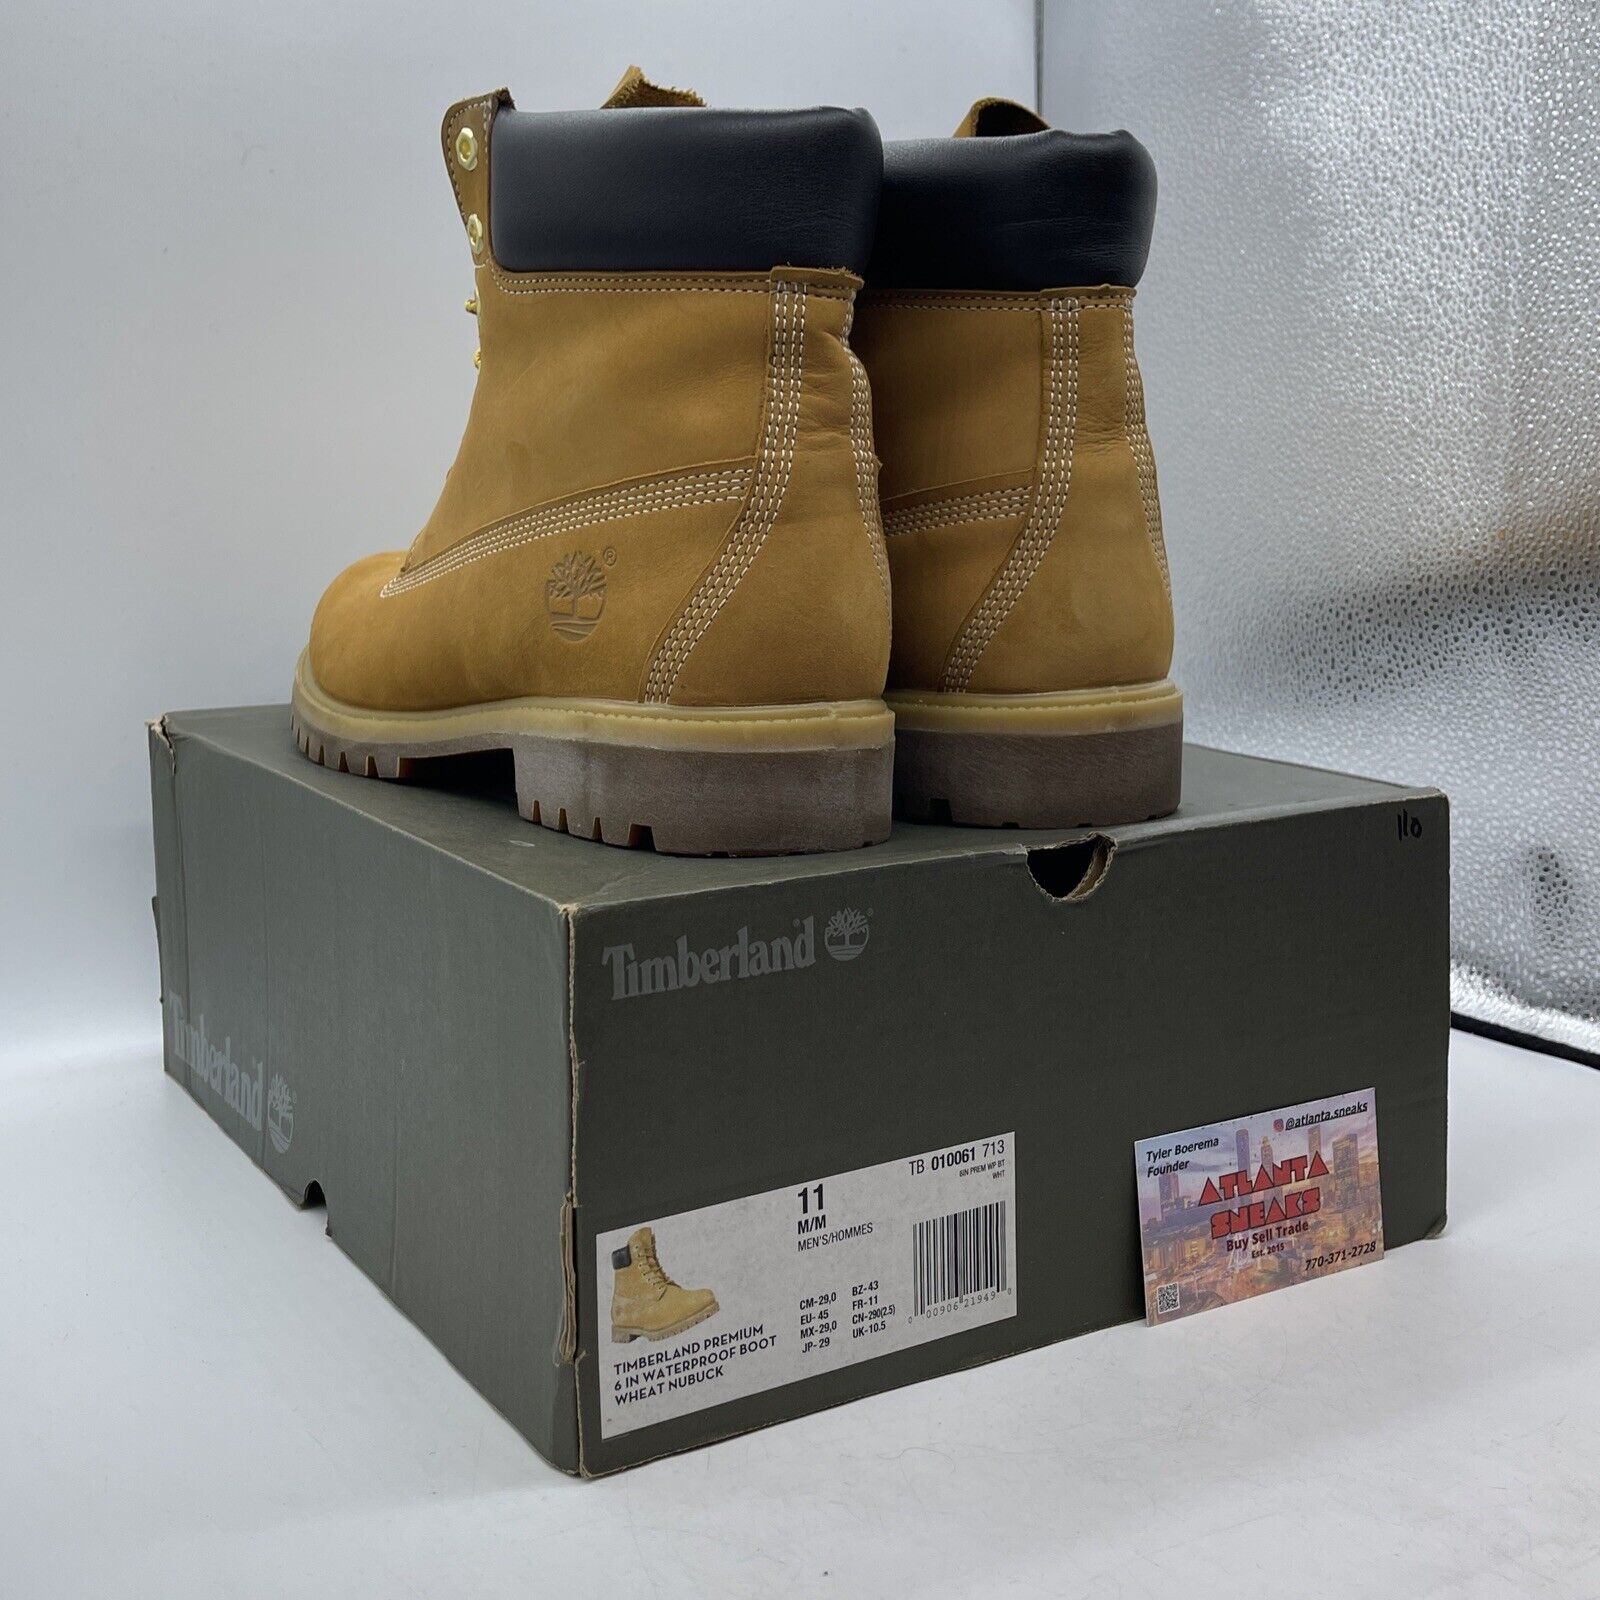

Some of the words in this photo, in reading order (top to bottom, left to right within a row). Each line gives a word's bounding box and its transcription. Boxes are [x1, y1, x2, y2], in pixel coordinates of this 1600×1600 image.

[601, 916, 817, 1000] Timberland
[169, 990, 264, 1131] Timberland
[1285, 1101, 1368, 1130] @atlanta.sneaks
[909, 1159, 925, 1176] TB
[931, 1147, 976, 1171] 010061
[982, 1139, 1005, 1157] 713
[1146, 1147, 1172, 1163] Tyler
[1174, 1136, 1219, 1156] Boerema
[970, 1164, 986, 1175] PREM
[987, 1162, 996, 1170] WP
[998, 1159, 1005, 1167] BT
[992, 1170, 1005, 1179] WHT
[1147, 1159, 1190, 1178] Founder
[1198, 1151, 1330, 1206] ATLANTA
[798, 1183, 824, 1215] 11
[1210, 1186, 1321, 1239] SNEAKS
[797, 1215, 826, 1235] M/M
[798, 1222, 873, 1252] MEN'S/HOMMES
[1226, 1237, 1249, 1252] Buy
[1252, 1228, 1273, 1245] Sell
[1275, 1221, 1309, 1239] Trade
[1251, 1249, 1266, 1259] Est.
[1267, 1243, 1285, 1256] 2015
[1304, 1240, 1376, 1271] 770-371-2728
[852, 1295, 878, 1311] FR-11
[852, 1320, 886, 1339] UK-10.5
[614, 1342, 701, 1375] TIMBERLAND
[704, 1324, 764, 1351] PREMIUM
[614, 1380, 622, 1391] 6
[625, 1375, 639, 1388] IN
[643, 1347, 737, 1382] WATERPROOF
[740, 1335, 777, 1355] BOOT
[615, 1382, 665, 1406] WHEAT
[668, 1365, 724, 1391] NUBUCK
